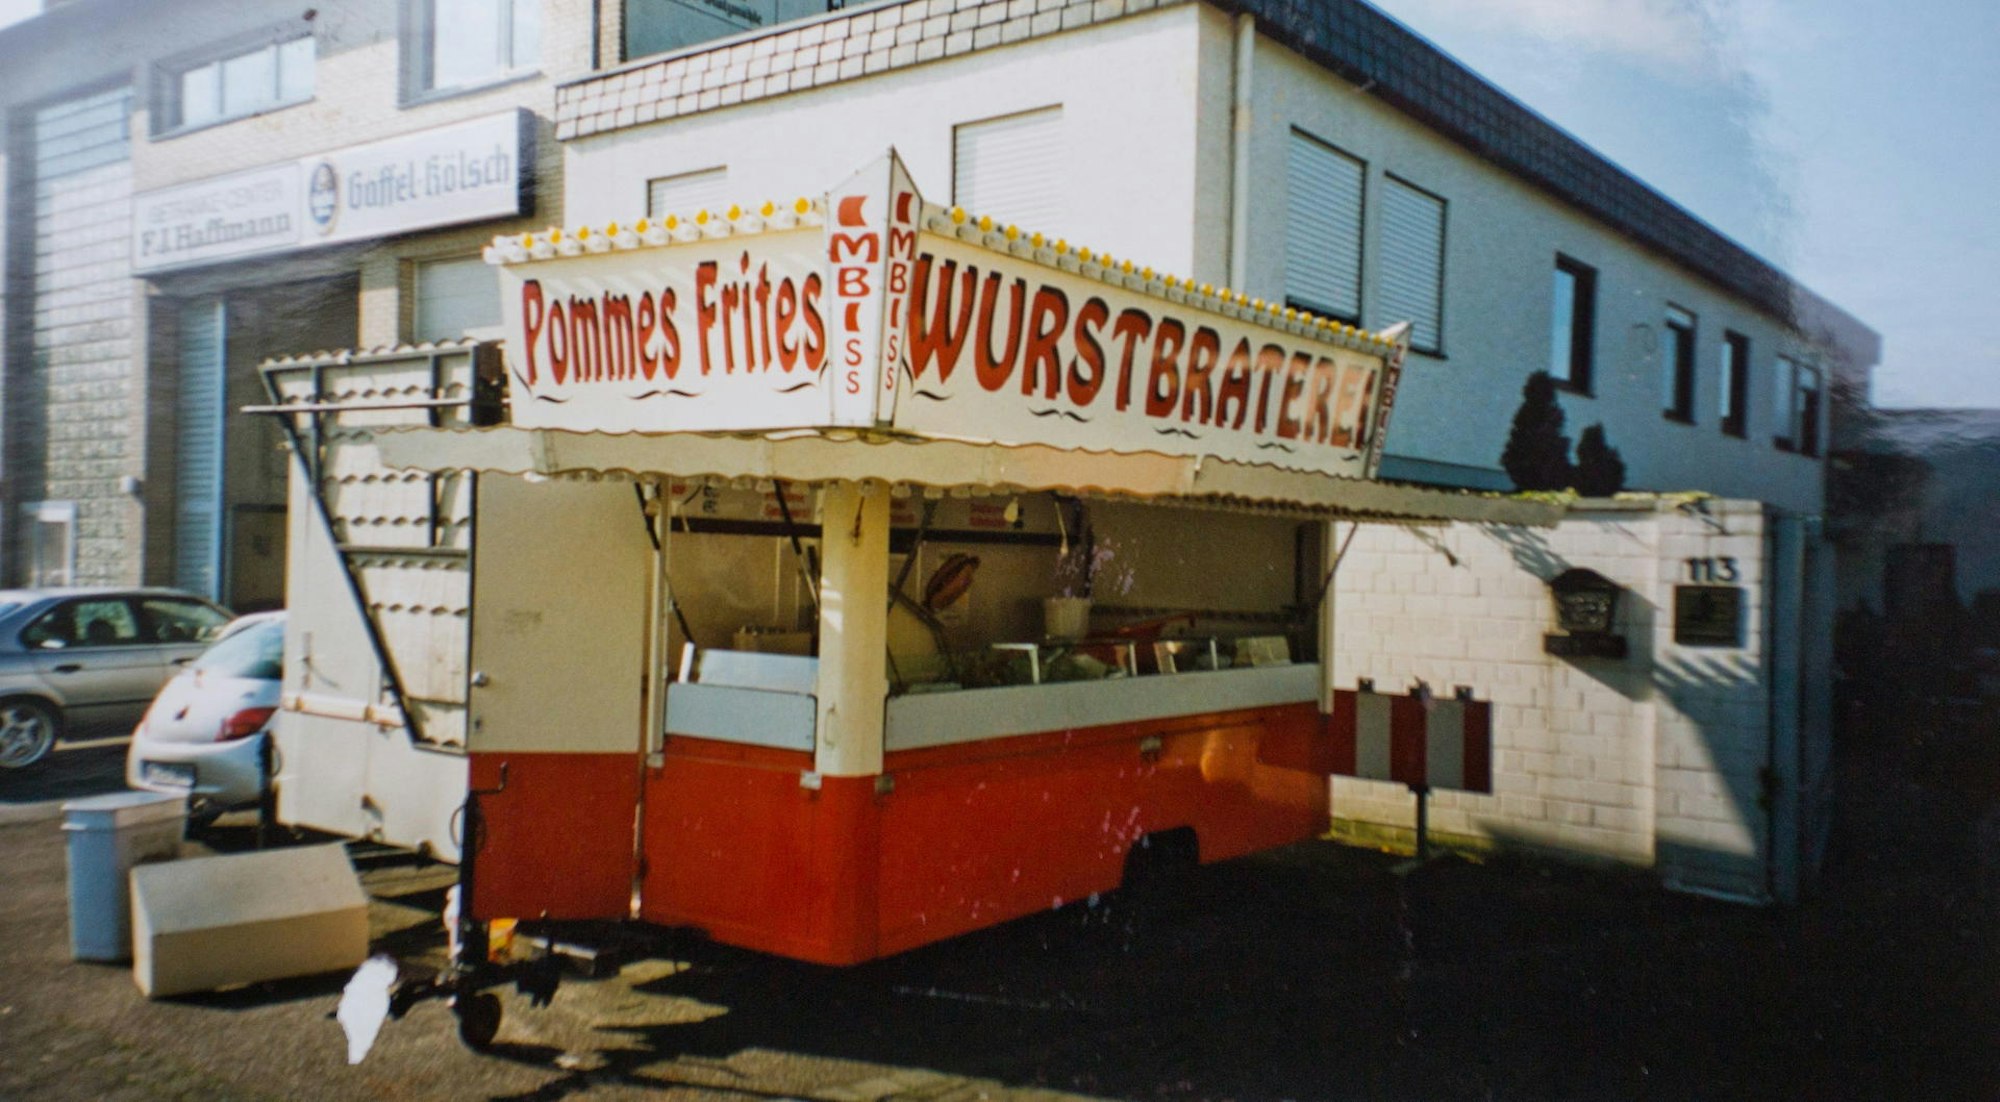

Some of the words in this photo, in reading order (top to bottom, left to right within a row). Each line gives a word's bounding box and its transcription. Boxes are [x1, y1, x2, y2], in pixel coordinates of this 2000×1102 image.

[521, 278, 682, 387] Pommes
[696, 249, 826, 376] Frites
[829, 194, 880, 394] IMBISS
[885, 191, 917, 391] IMBISS
[907, 251, 1378, 451] WURSTBRATEREI
[1683, 556, 1738, 581] 113
